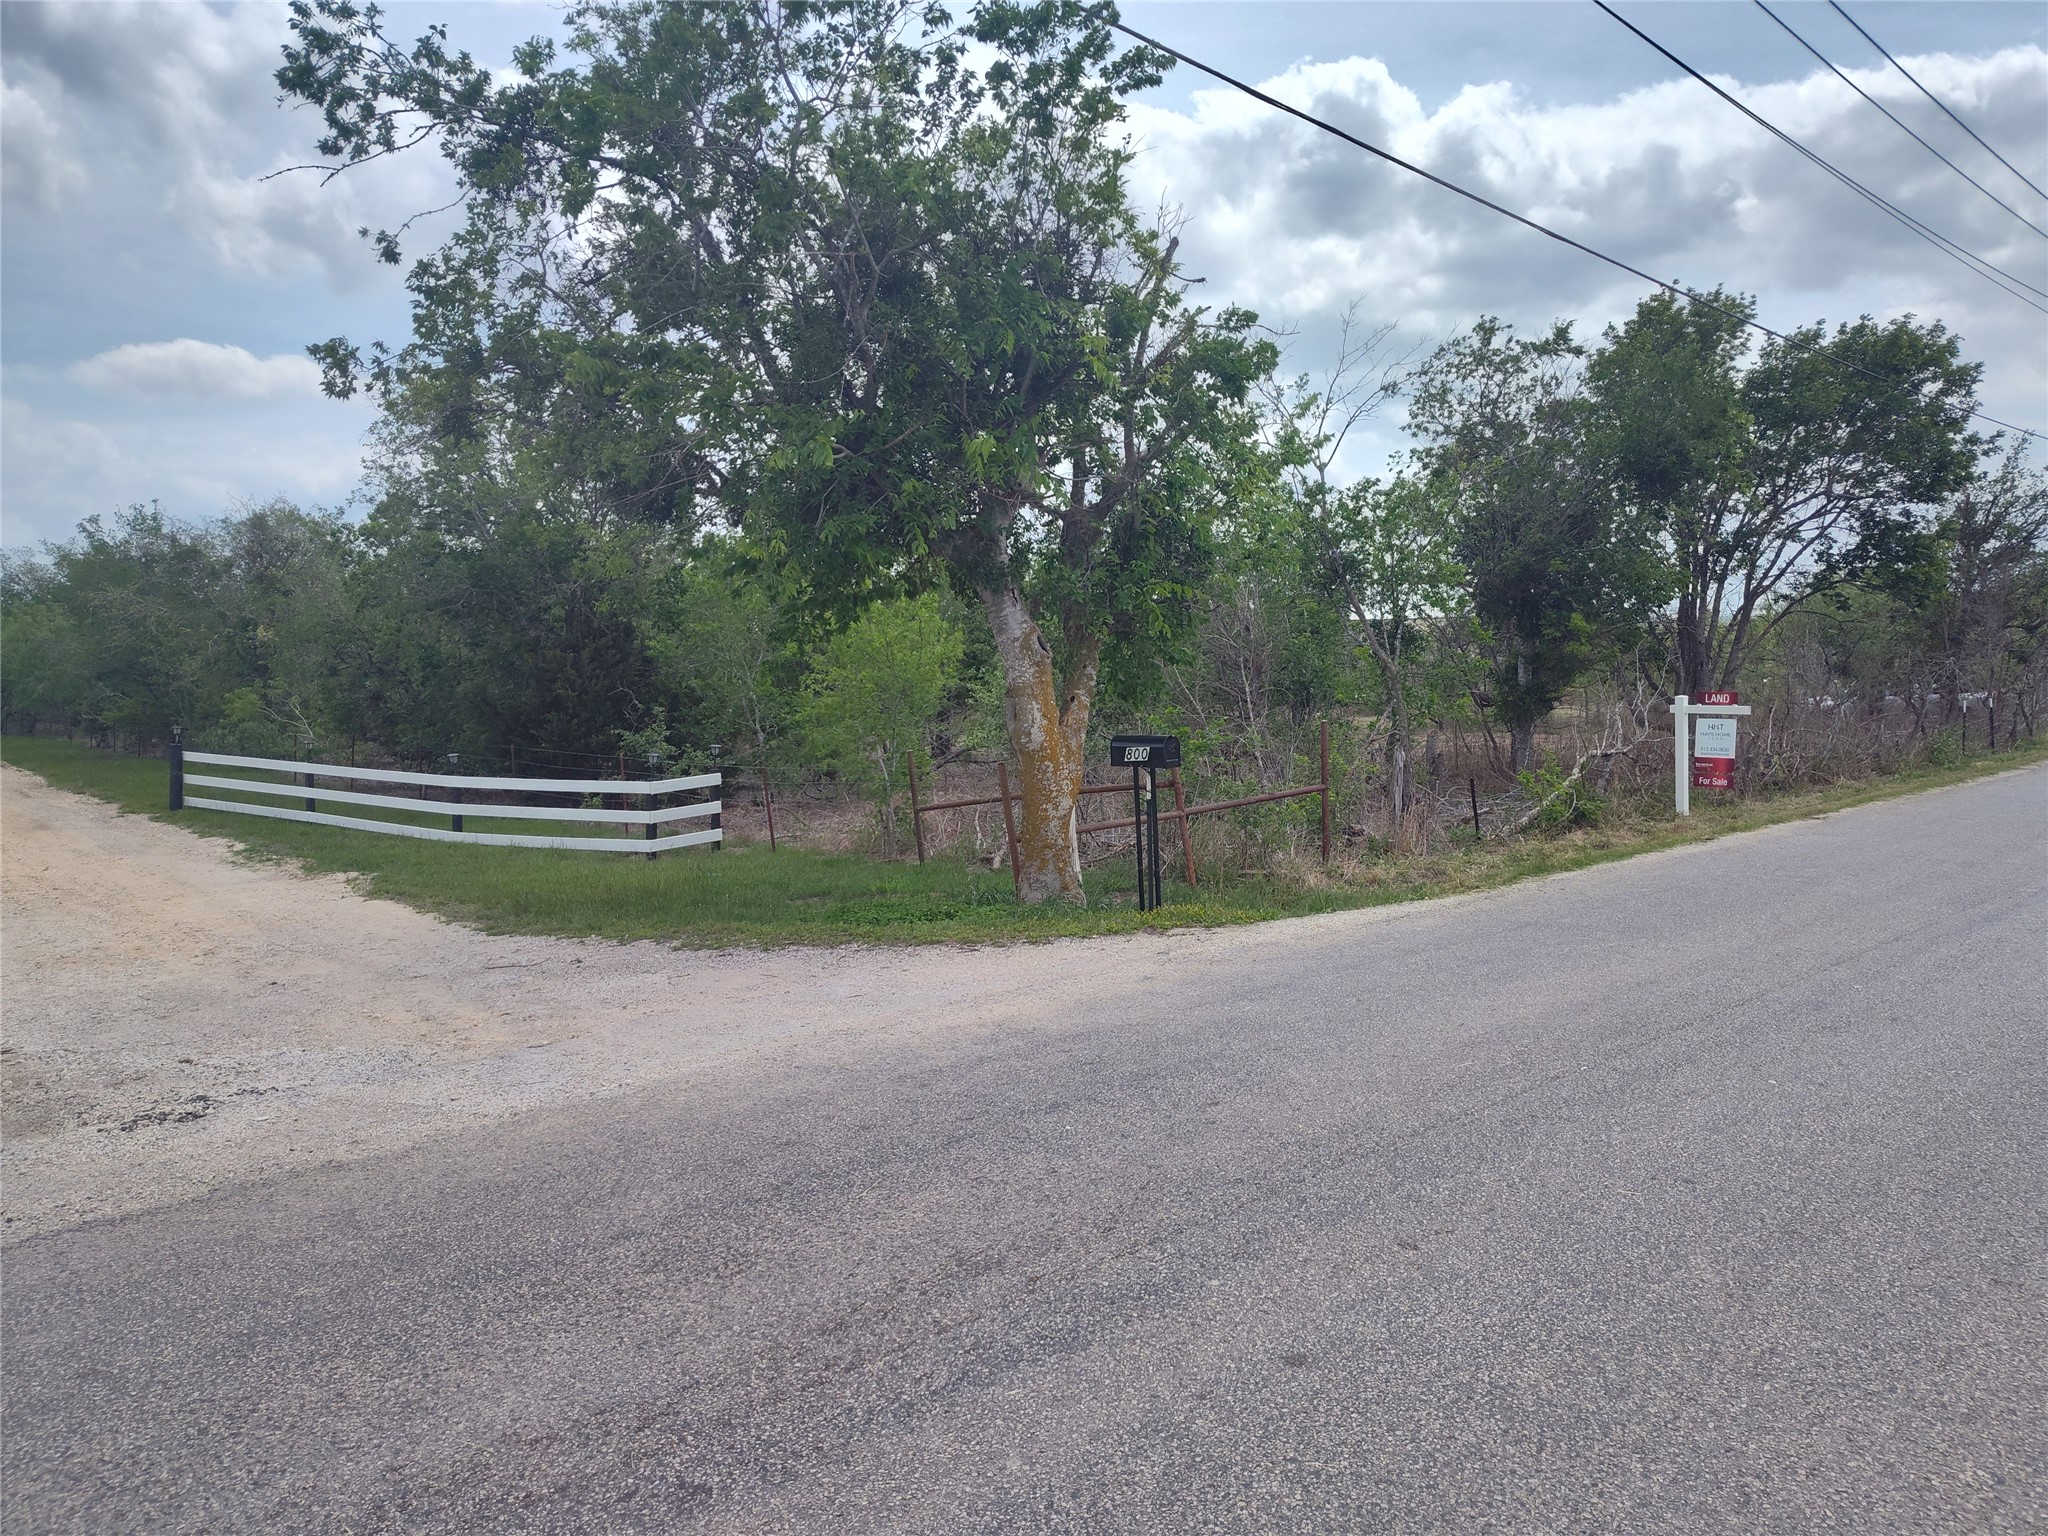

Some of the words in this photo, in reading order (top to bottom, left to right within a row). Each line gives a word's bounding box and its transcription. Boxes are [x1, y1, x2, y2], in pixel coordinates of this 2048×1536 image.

[1705, 693, 1730, 703] LAND
[1126, 748, 1148, 760] 800
[1699, 776, 1711, 785] For
[1712, 777, 1728, 786] Sale
